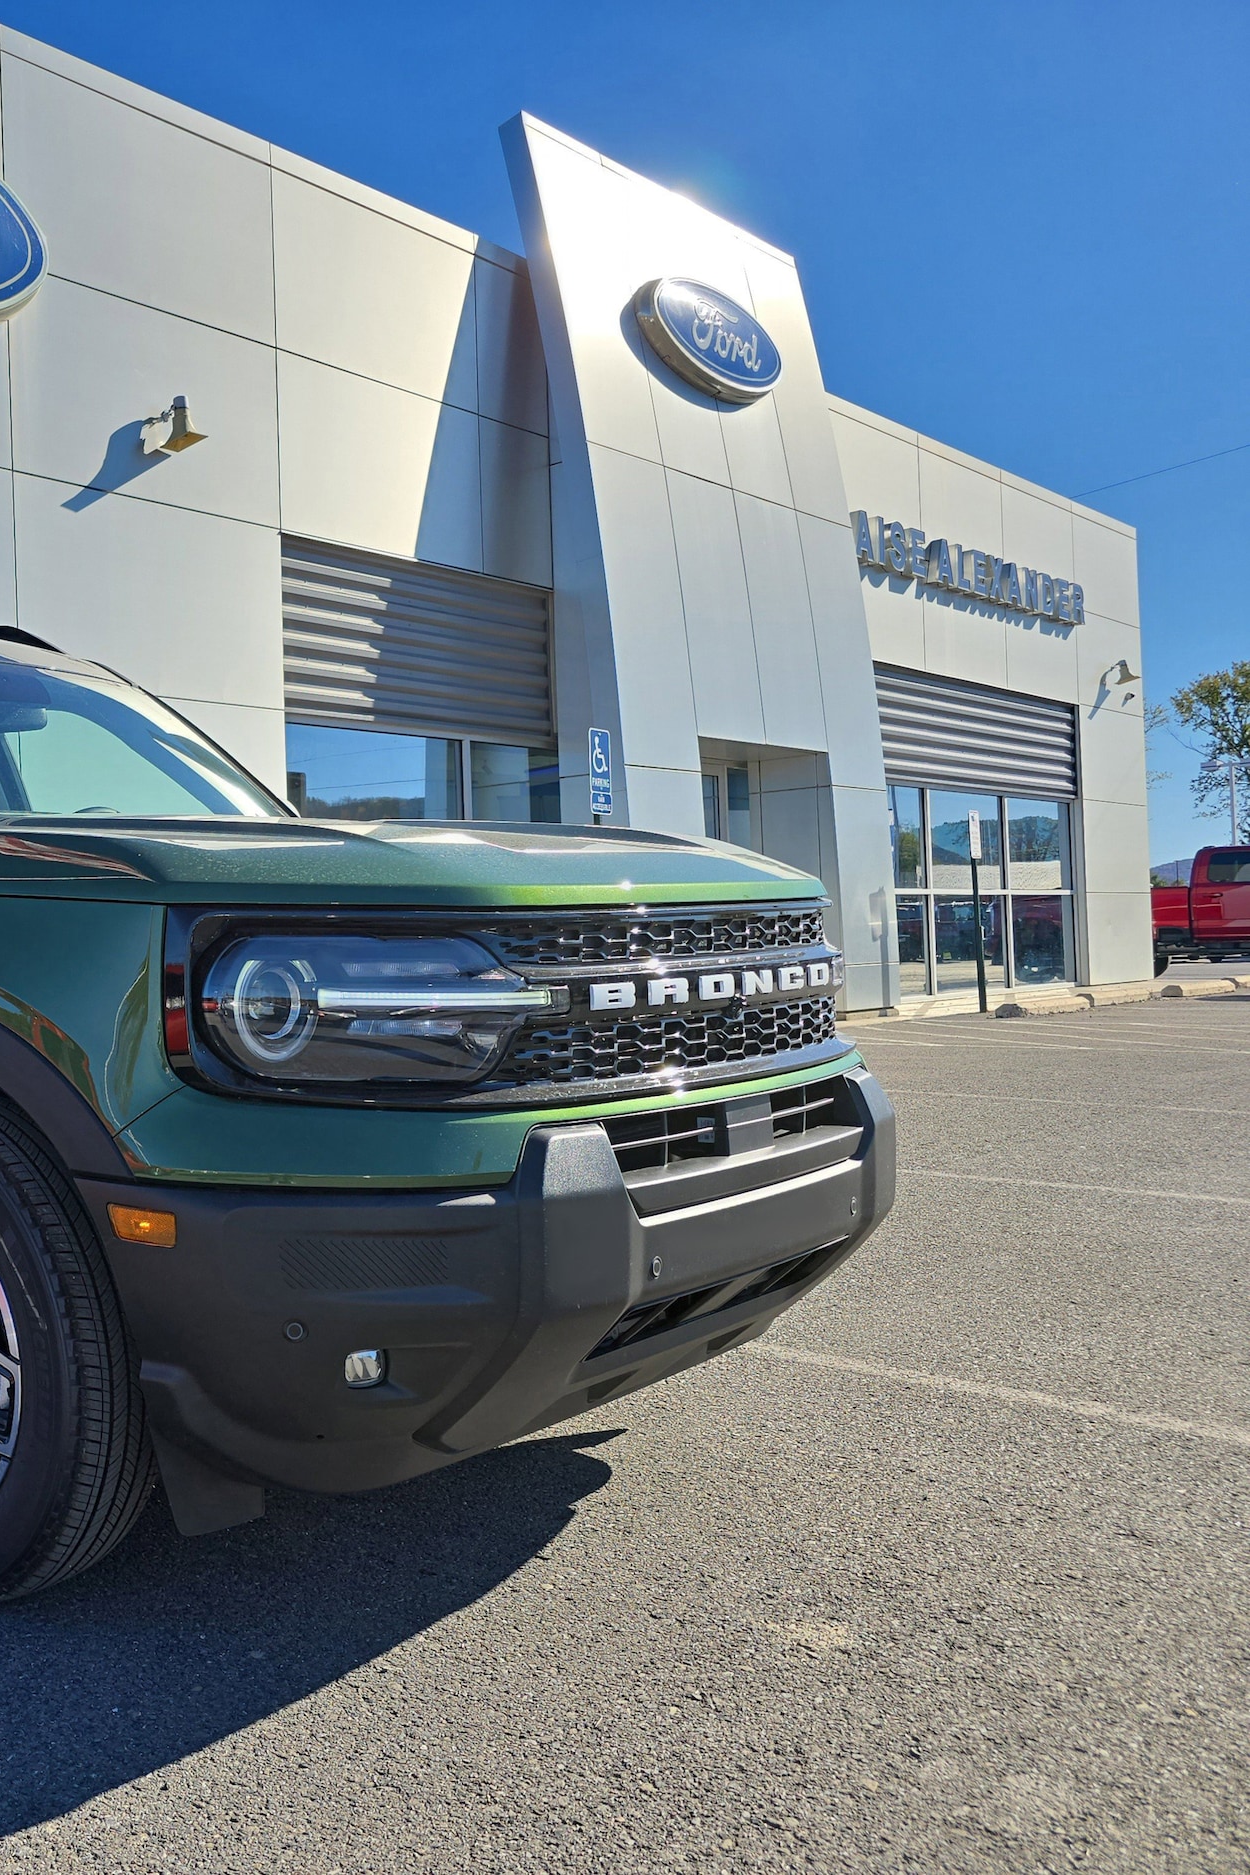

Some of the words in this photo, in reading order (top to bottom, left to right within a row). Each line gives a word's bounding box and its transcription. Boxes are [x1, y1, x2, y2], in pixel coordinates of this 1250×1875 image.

[692, 298, 762, 373] Ford
[850, 510, 926, 578] AISE
[928, 538, 1085, 625] ALEXANDER
[590, 962, 829, 1010] BRONCO
